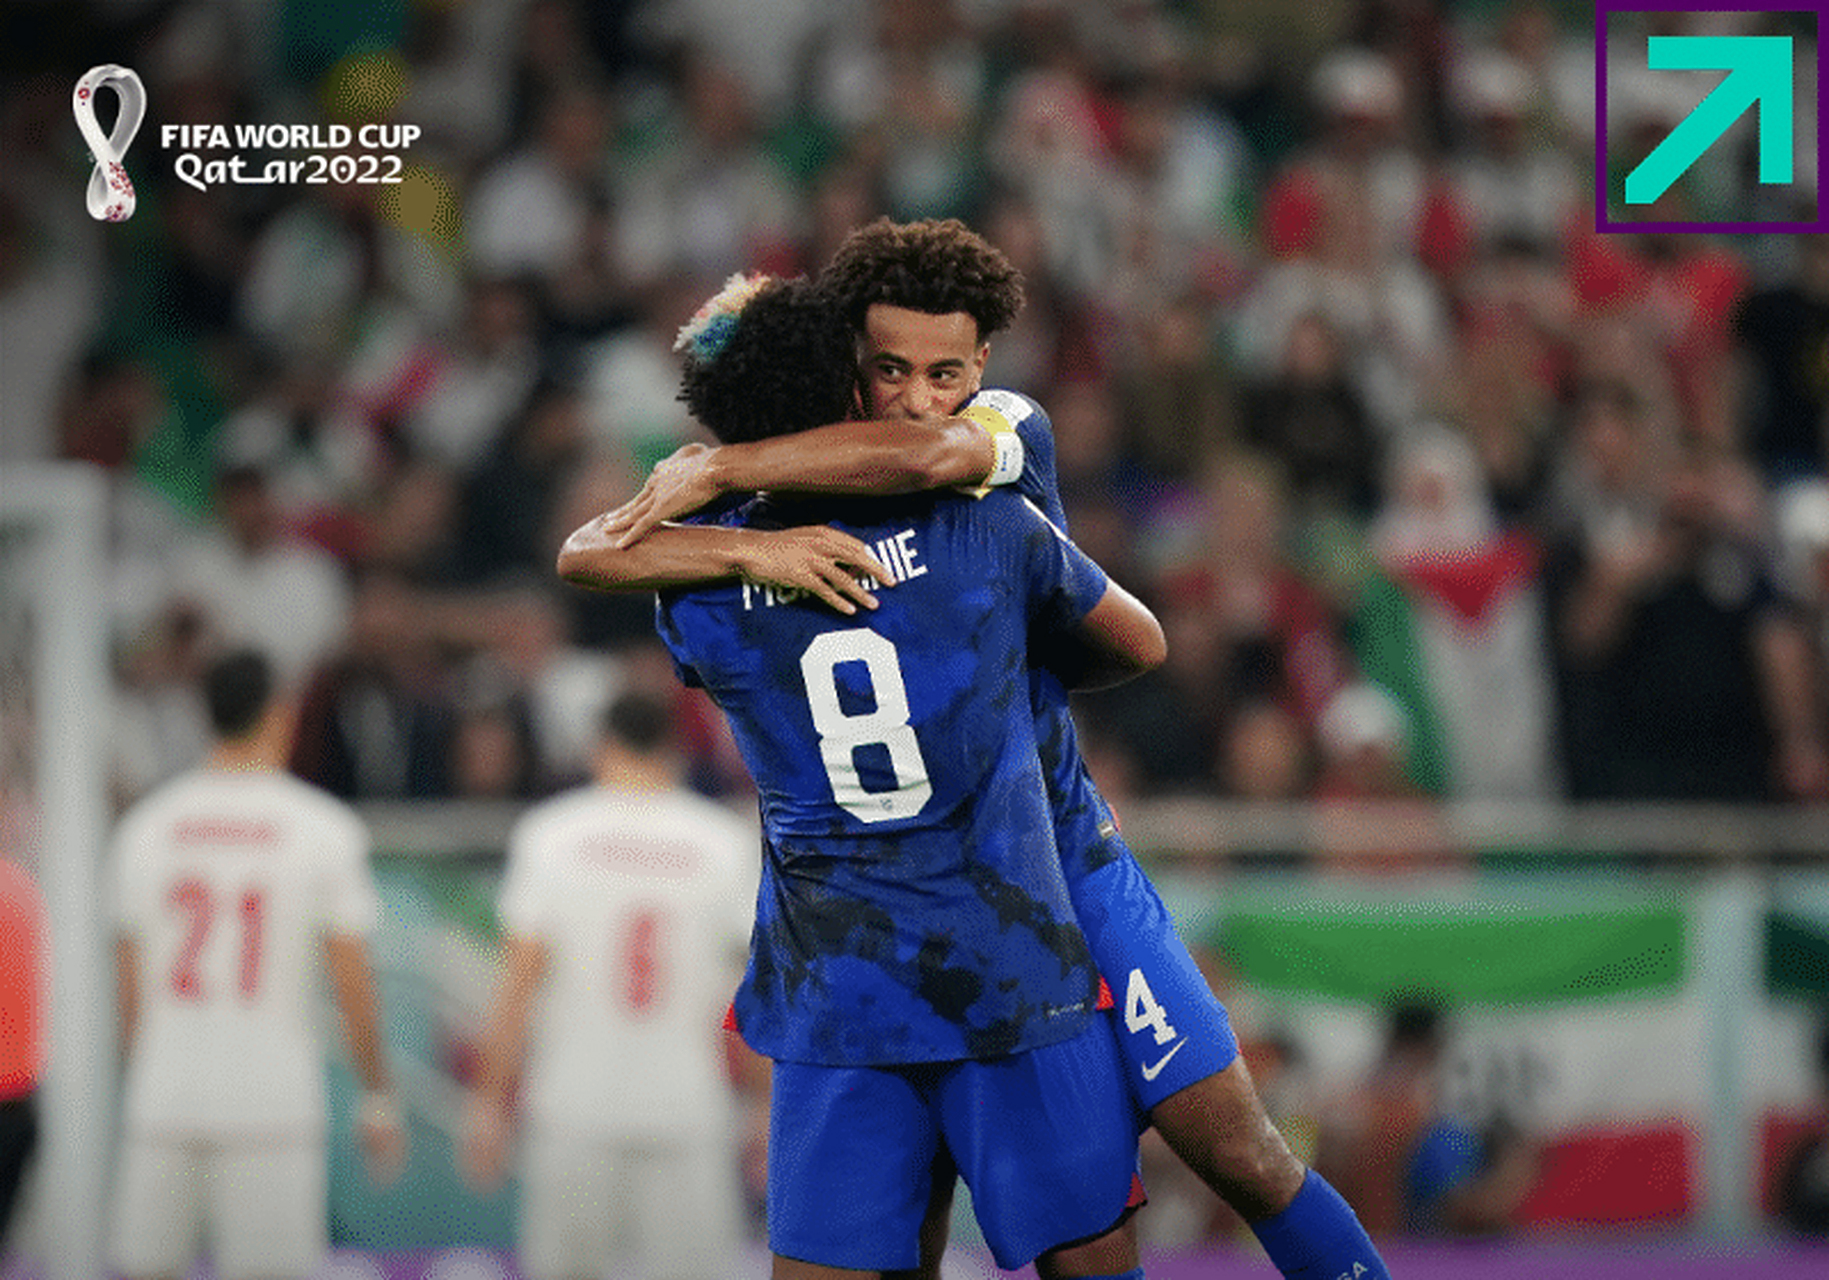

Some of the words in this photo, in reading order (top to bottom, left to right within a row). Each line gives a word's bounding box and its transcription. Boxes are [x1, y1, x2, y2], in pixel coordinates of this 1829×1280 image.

[800, 627, 933, 823] 8
[165, 873, 268, 1004] 21
[1125, 967, 1178, 1046] 4
